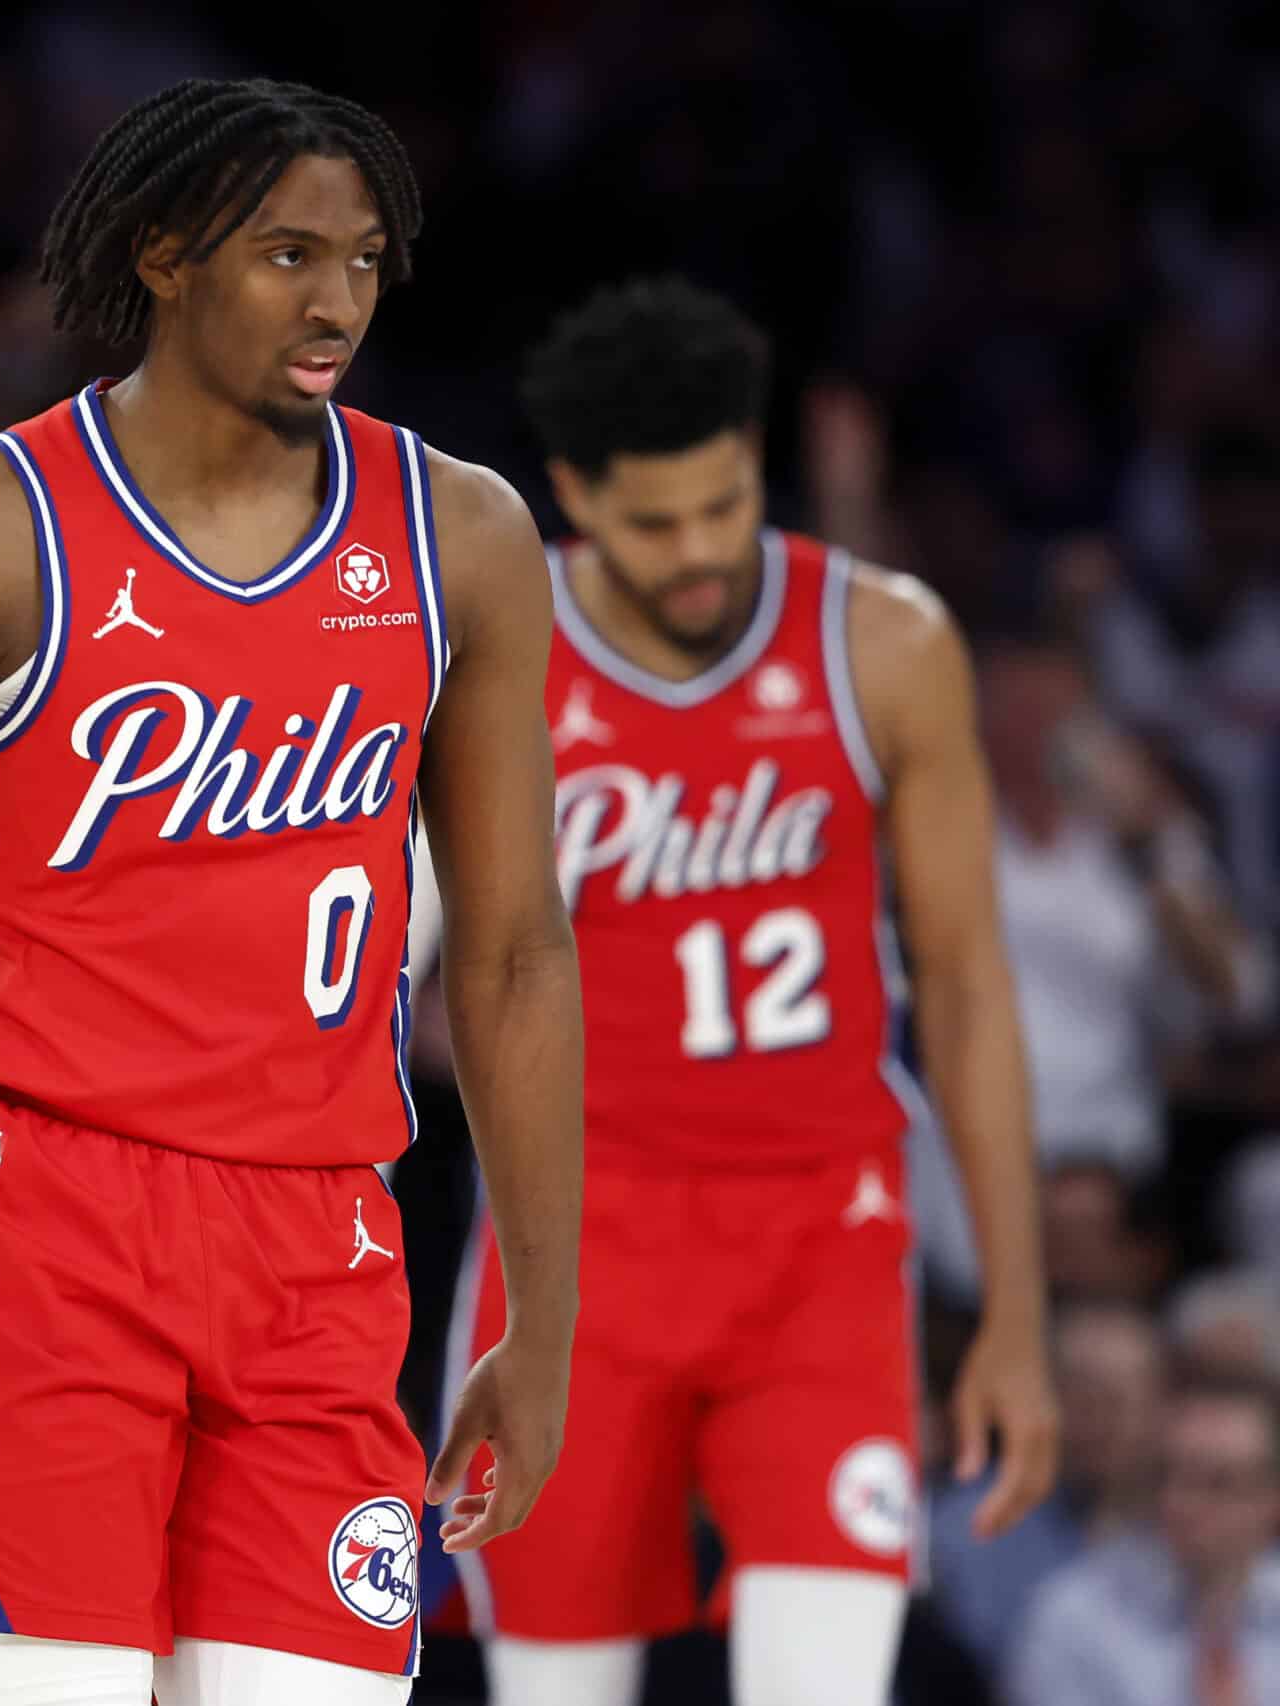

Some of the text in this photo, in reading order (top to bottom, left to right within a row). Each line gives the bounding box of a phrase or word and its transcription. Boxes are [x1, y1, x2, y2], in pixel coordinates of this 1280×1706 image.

[321, 611, 418, 632] crypto.com
[47, 680, 408, 872] Phila
[554, 757, 834, 915] Phila
[303, 864, 376, 1031] 0
[675, 906, 832, 1058] 12
[341, 1536, 413, 1604] 76ers
